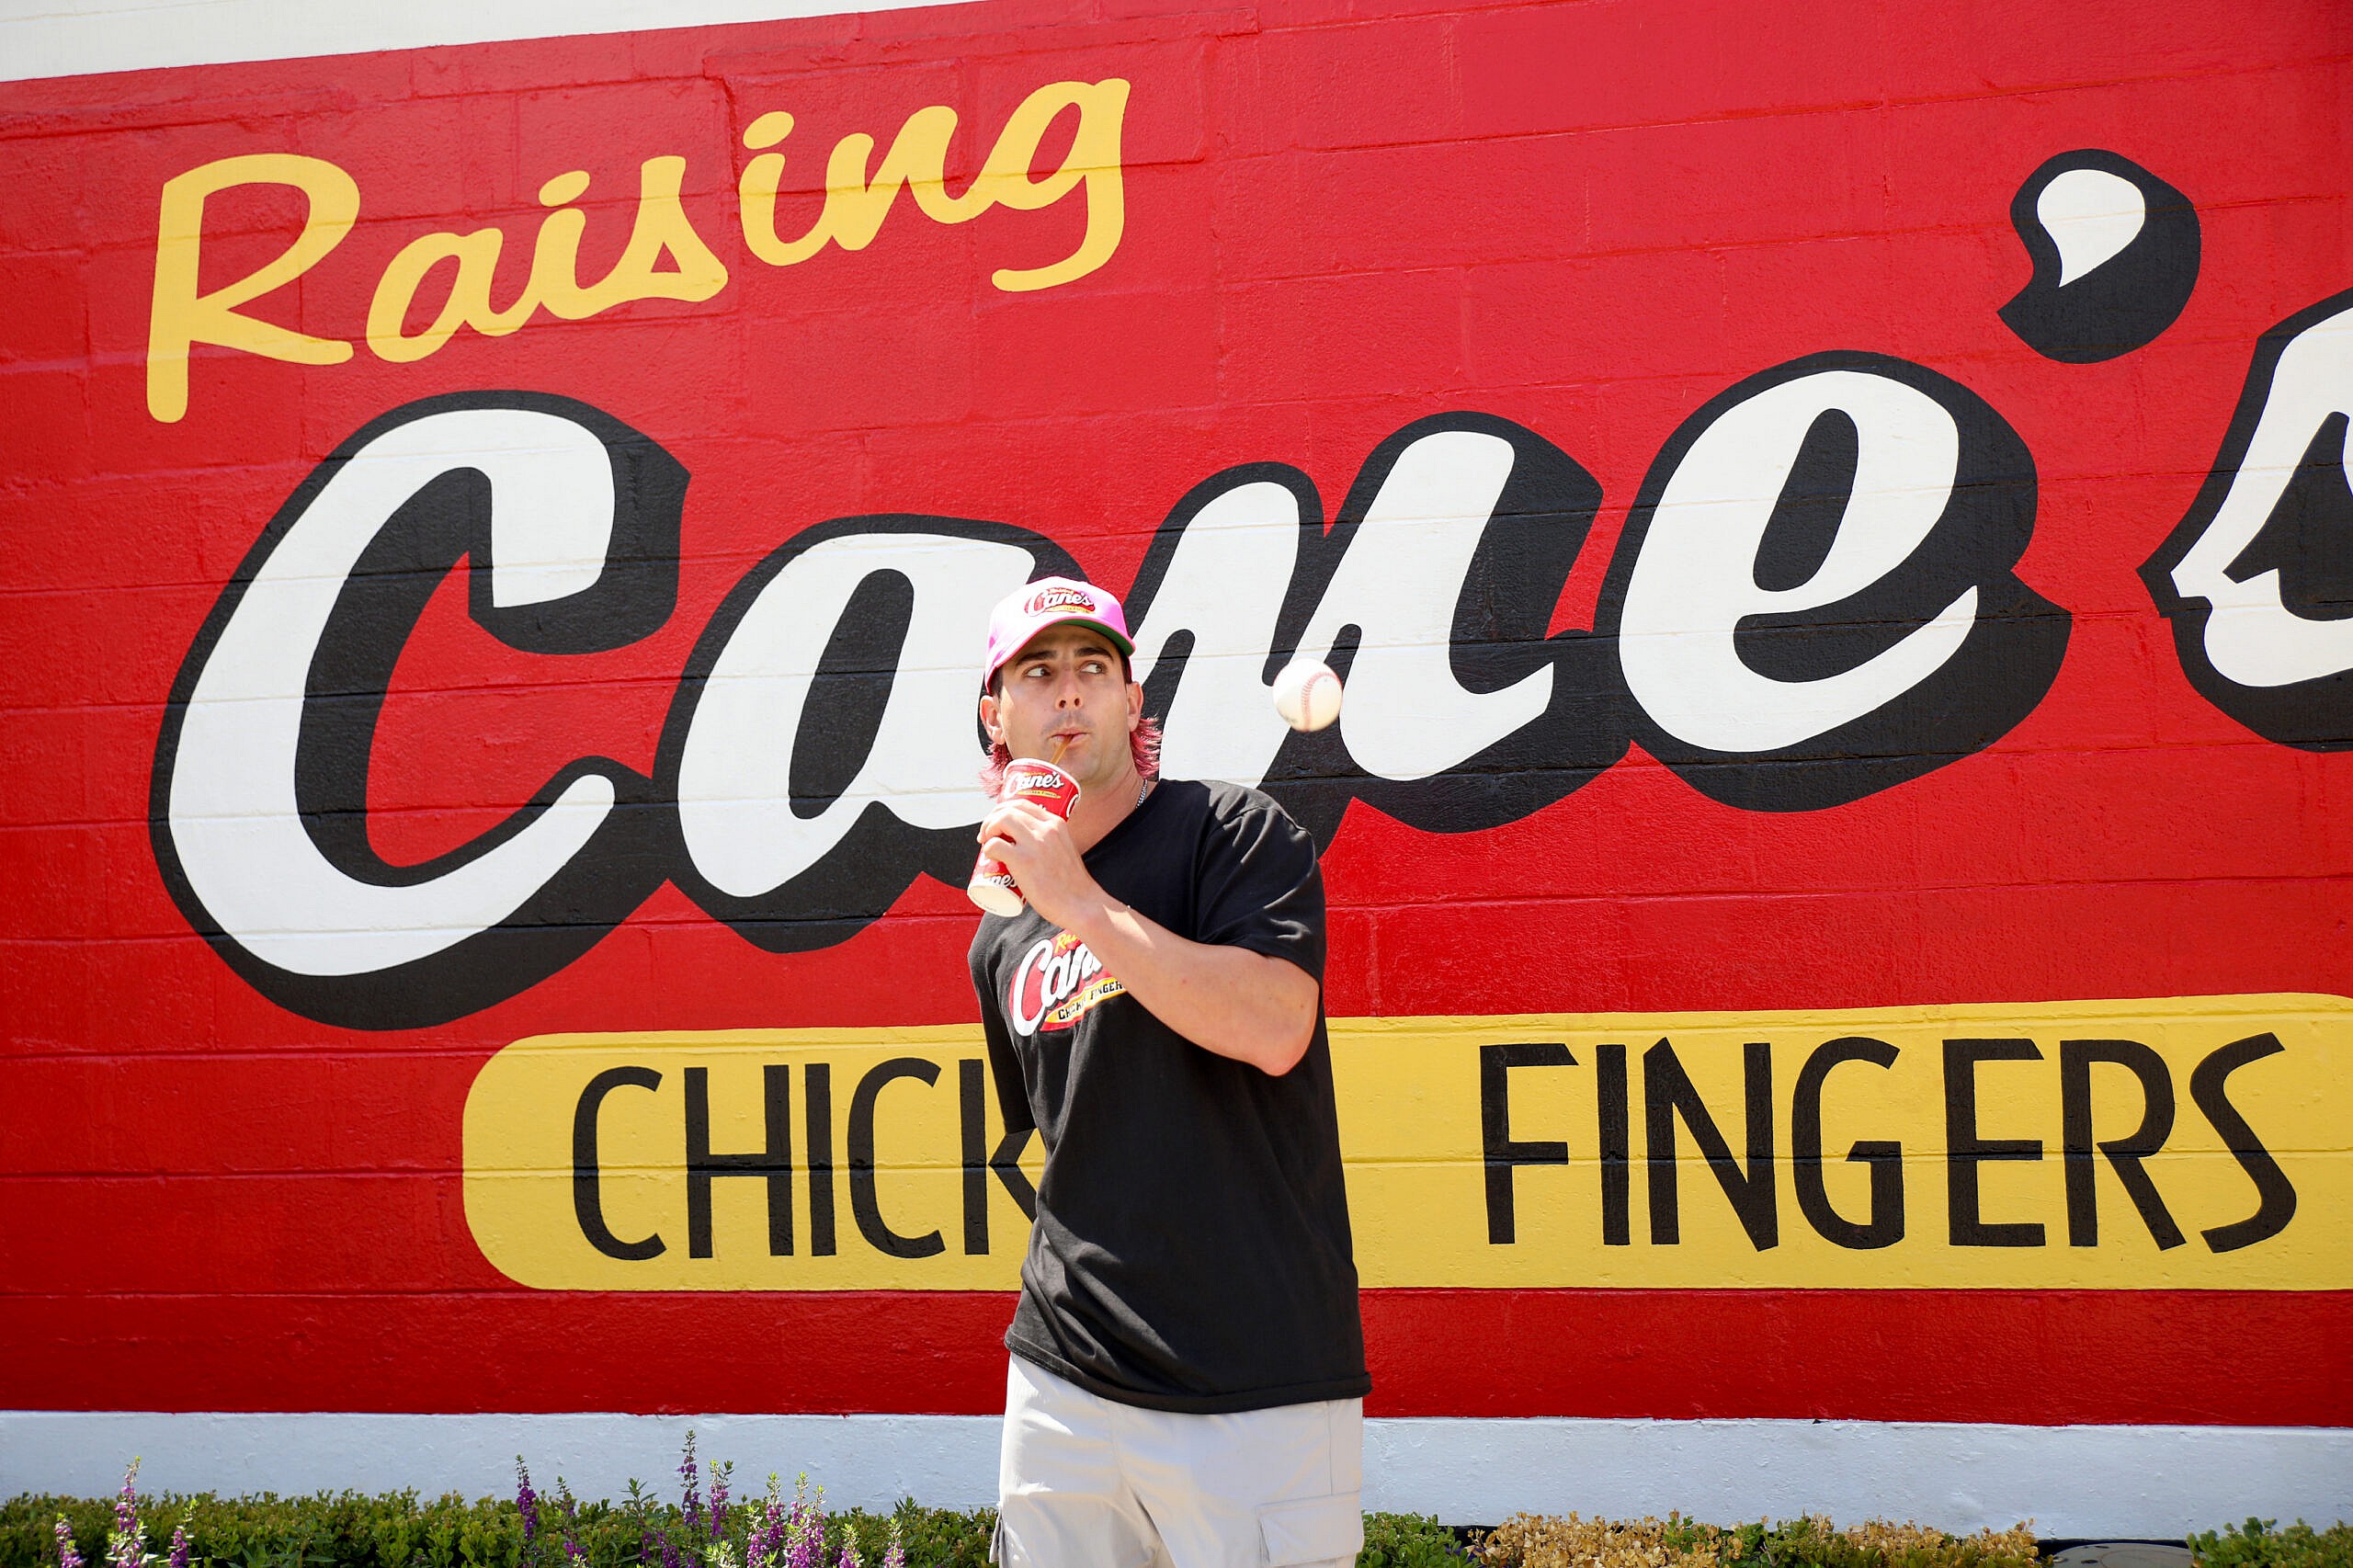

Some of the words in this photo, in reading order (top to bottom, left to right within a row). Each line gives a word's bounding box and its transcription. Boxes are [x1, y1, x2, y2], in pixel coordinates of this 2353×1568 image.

[146, 77, 1131, 424] Raising
[150, 150, 2353, 1029] Cane's
[1027, 590, 1094, 617] Cane's
[1004, 771, 1065, 799] Cane's
[572, 1057, 1037, 1261] CHICK
[1480, 1032, 2298, 1254] FINGERS
